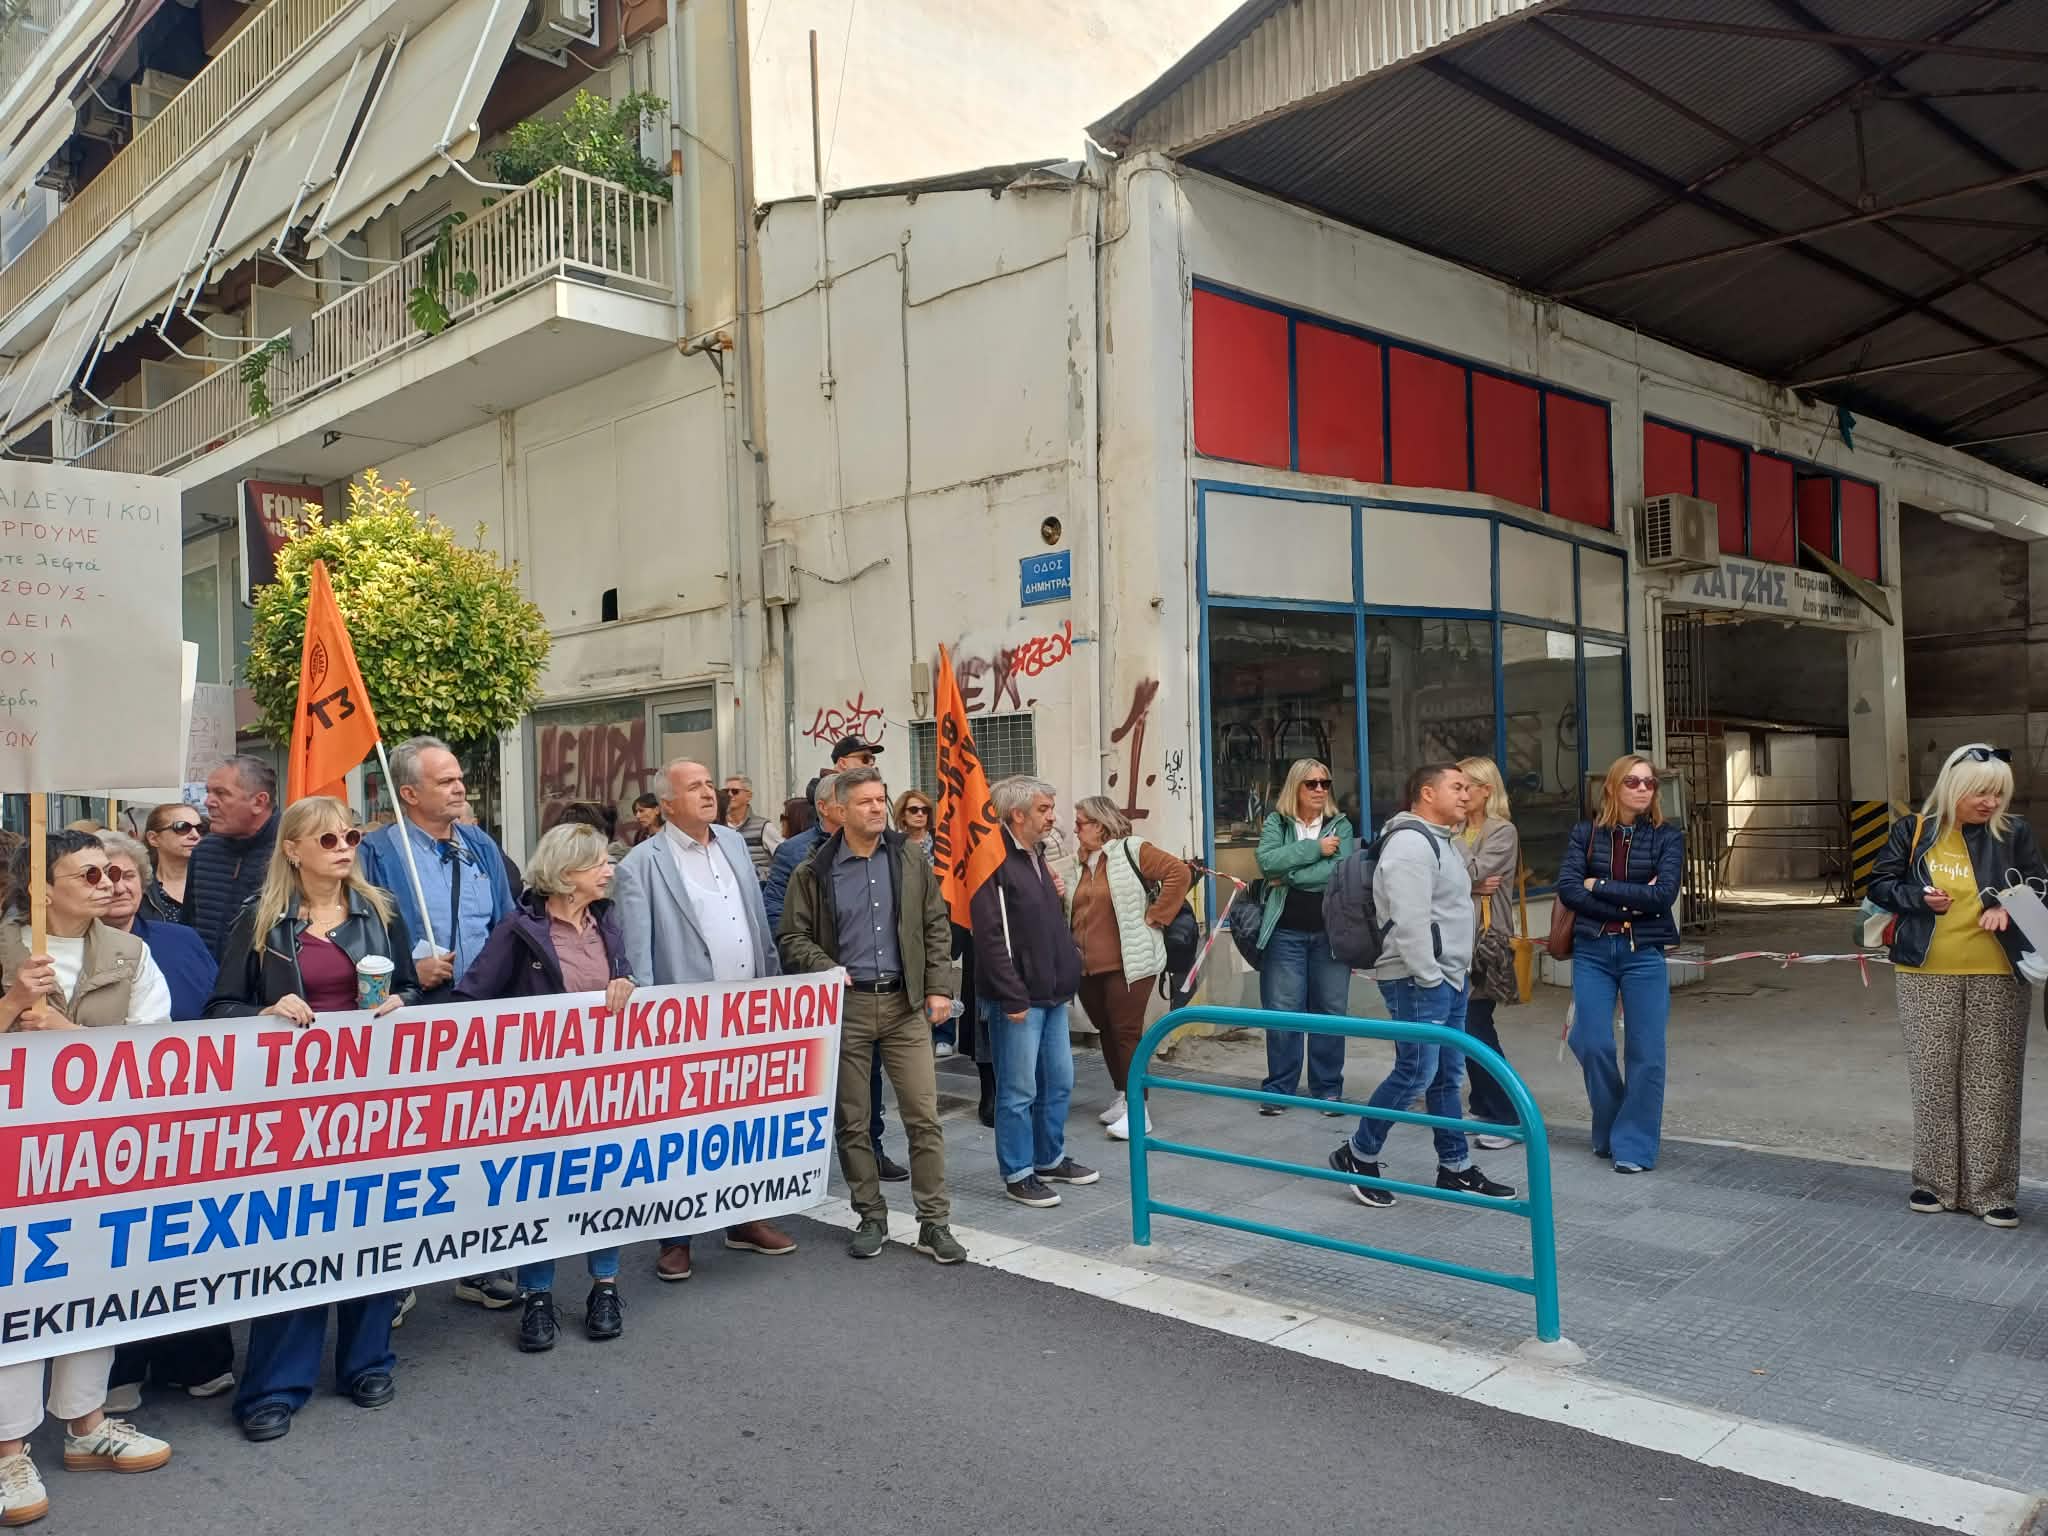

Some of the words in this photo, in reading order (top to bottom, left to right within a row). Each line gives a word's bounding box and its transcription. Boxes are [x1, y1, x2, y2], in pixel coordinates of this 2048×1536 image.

[7, 611, 72, 629] ΔΕΙΑ
[1033, 559, 1063, 574] ΟΔΟΣ
[0, 730, 39, 747] ΩΝ
[52, 1034, 236, 1105] ΟΛΩΝ
[257, 1025, 373, 1087] ΤΩΝ
[389, 994, 709, 1075] ΠΡΑΓΜΑΤΙΚΩΝ
[721, 983, 840, 1038] ΚΕΝΩΝ
[17, 1110, 283, 1198] ΜΑΘΗΤΗΣ
[292, 1095, 431, 1162] ΧΩΡΙΣ
[440, 1065, 671, 1142] ΠΑΡΑΛΛΗΛΗ
[679, 1047, 807, 1109] ΣΤΗΡΙΞΗ
[99, 1163, 460, 1268] ΤΕΧΝΗΤΕΣ
[480, 1106, 829, 1207] ΥΠΕΡΑΡΙΘΜΙΕΣ
[2, 1252, 343, 1344] ΕΚΠΑΙΔΕΥΤΙΚΩΝ
[356, 1242, 402, 1277] ΠΕ
[413, 1217, 550, 1267] ΛΑΡΙΣΑΣ
[567, 1192, 708, 1237] "ΚΩΝ/ΝΟΣ
[715, 1168, 821, 1213] ΚΟΥΜΑΣ"
